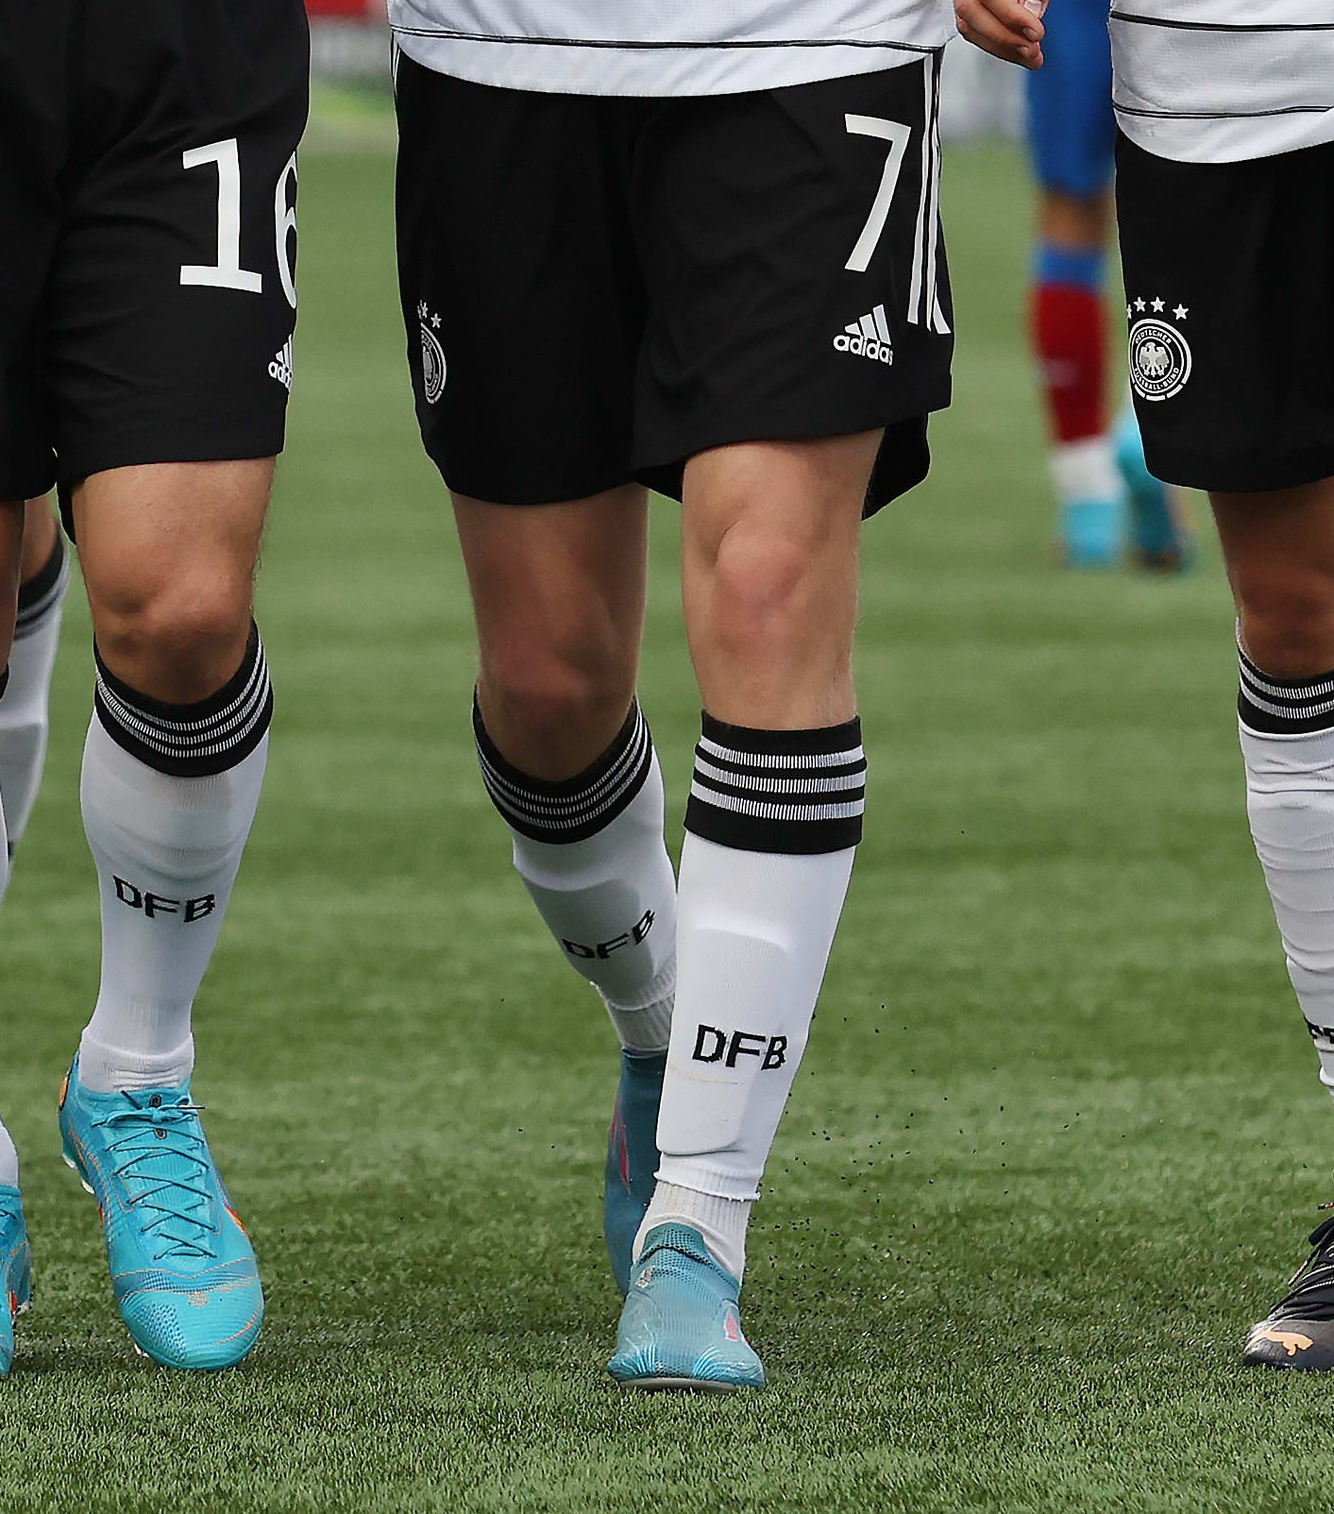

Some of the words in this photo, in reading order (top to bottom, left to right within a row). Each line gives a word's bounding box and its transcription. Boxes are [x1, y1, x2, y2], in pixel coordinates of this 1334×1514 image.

[844, 112, 911, 272] 7
[833, 329, 894, 366] adidas
[112, 874, 216, 925] DFB
[561, 908, 657, 961] DFB
[692, 1023, 789, 1071] DFB
